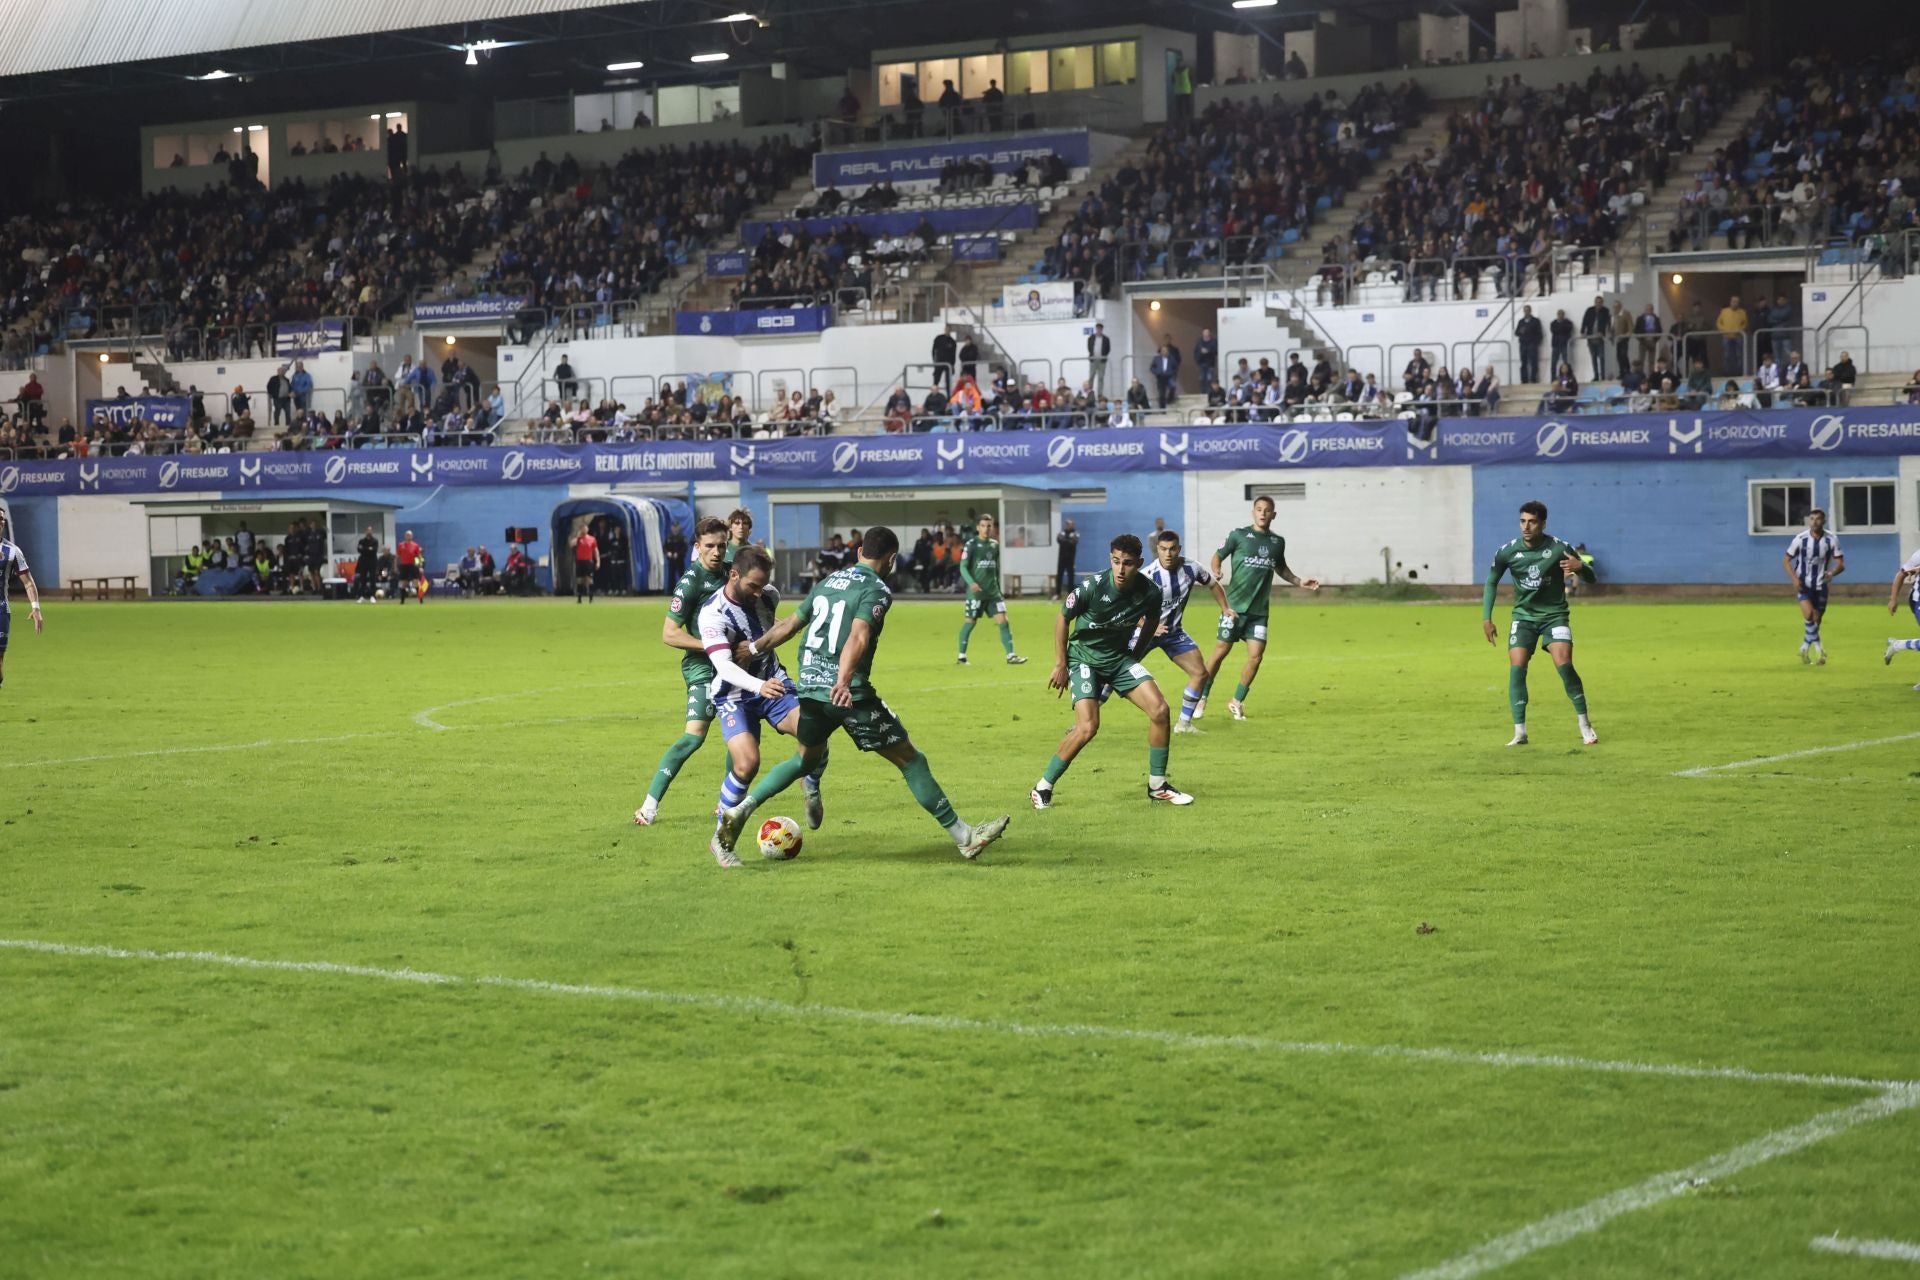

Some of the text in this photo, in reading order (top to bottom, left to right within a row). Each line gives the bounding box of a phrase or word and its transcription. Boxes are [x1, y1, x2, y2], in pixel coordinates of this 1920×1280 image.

[840, 163, 887, 176] REAL
[415, 301, 525, 315] www.realavilesc.co
[757, 315, 795, 328] 1903
[1572, 430, 1650, 444] FRESAMEX
[1708, 424, 1787, 440] HORIZONTE
[1848, 422, 1920, 438] FRESAME
[1194, 438, 1260, 452] HORIZONTE
[1311, 437, 1384, 451] FRESAMEX
[1443, 432, 1515, 446] HORIZONTE
[758, 450, 817, 464] HORIZONTE
[860, 448, 923, 462] FRESAMEX
[968, 444, 1030, 458] HORIZONTE
[1077, 443, 1144, 457] FRESAMEX
[348, 462, 399, 474] FRESAMEX
[437, 458, 488, 471] HORIZONTE
[527, 458, 581, 471] FRESAMEX
[595, 451, 717, 472] REAL AVILÉS INDUSTRIAL
[101, 468, 147, 480] HORIZONTE
[180, 467, 229, 479] FRESAMEX
[264, 463, 312, 475] HORIZONTE
[20, 472, 65, 483] FRESAMEX
[805, 595, 846, 654] 21
[1080, 664, 1091, 679] 6
